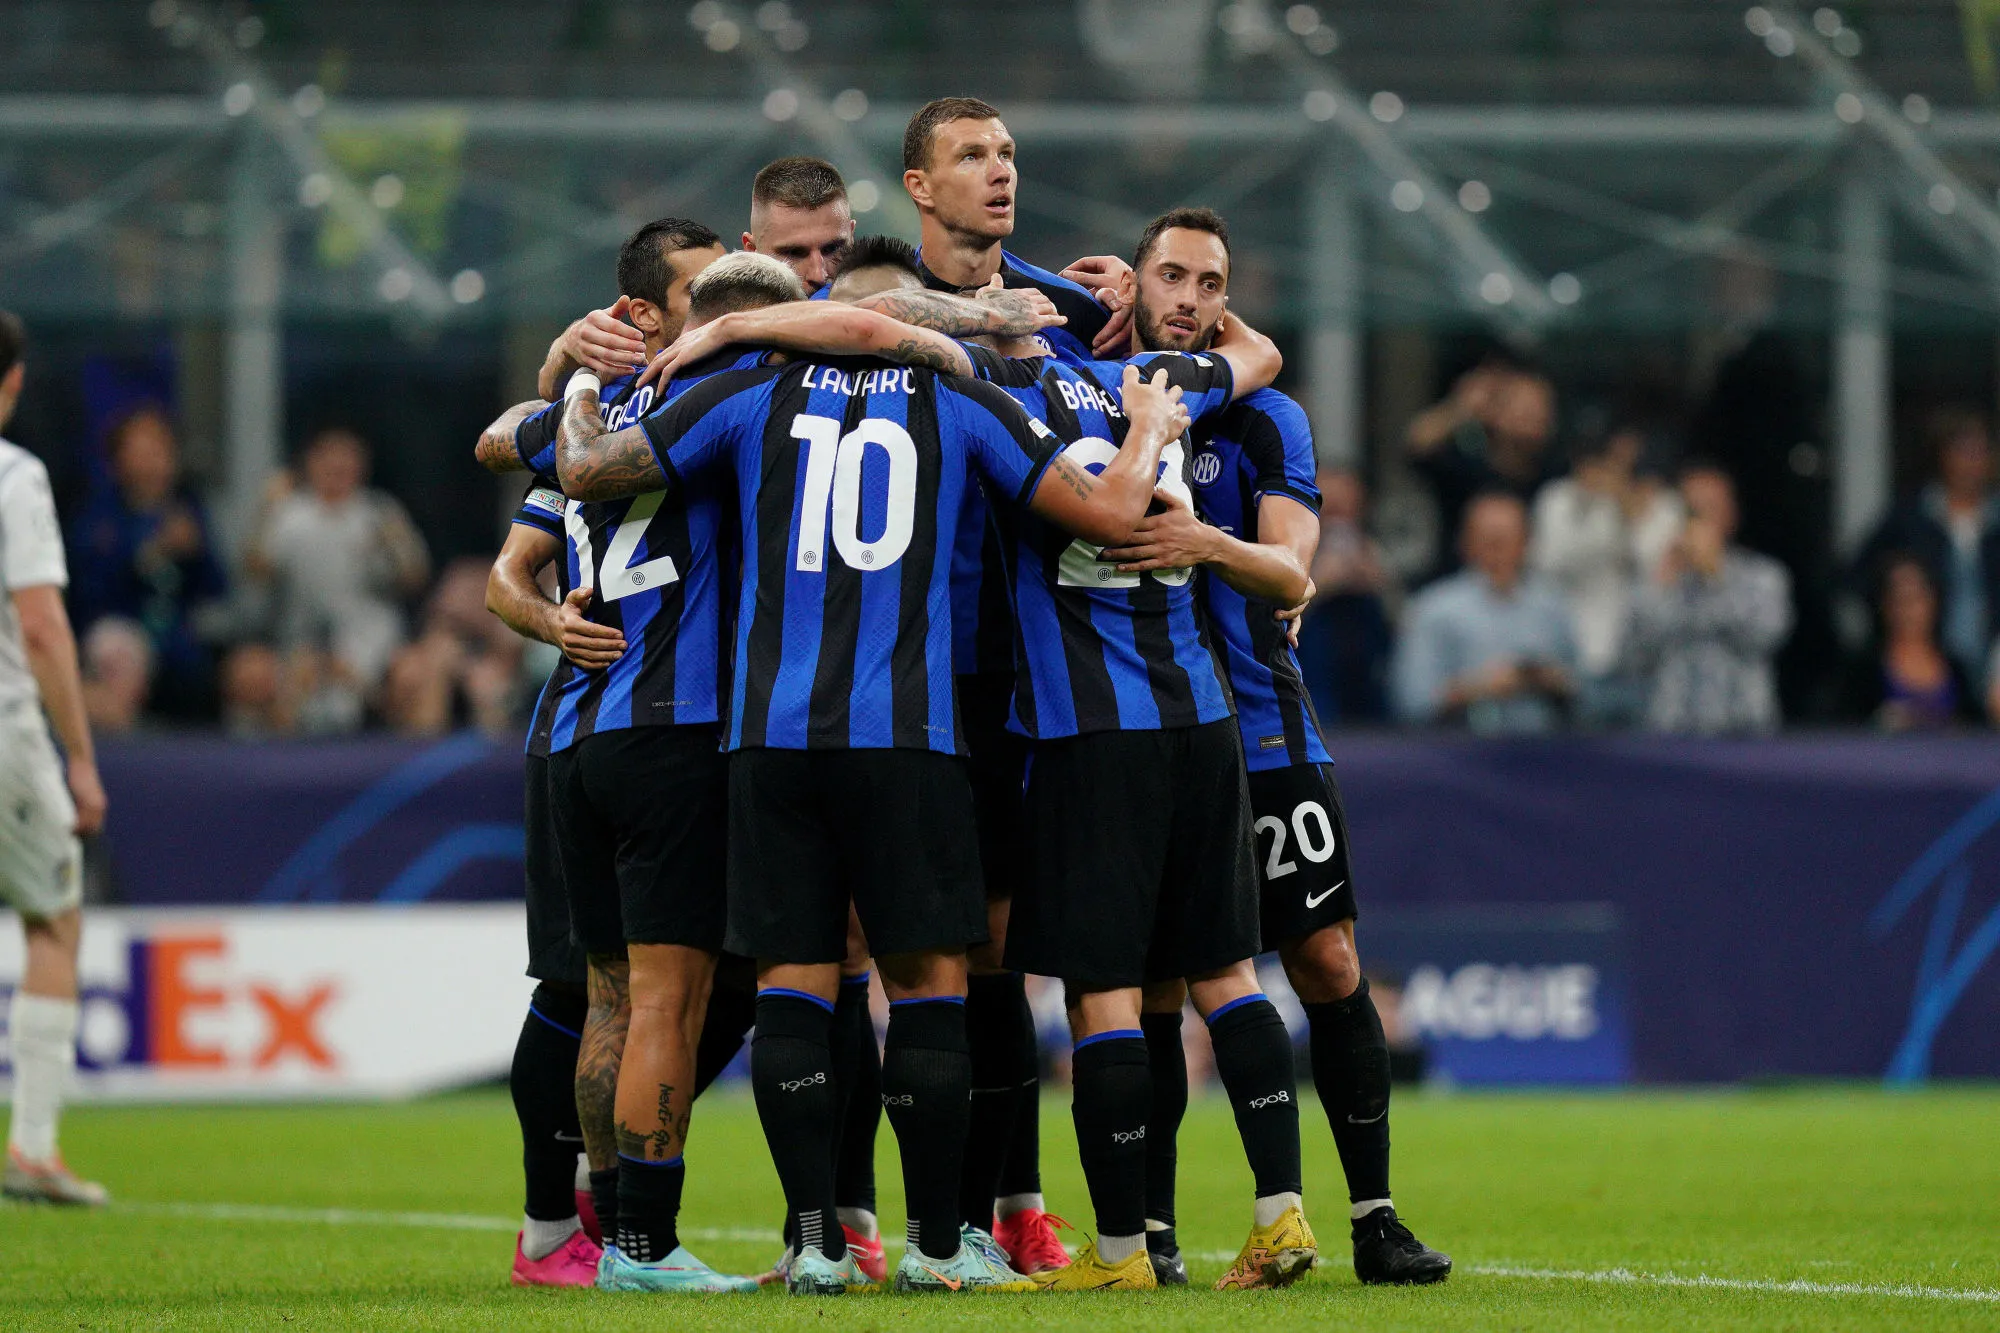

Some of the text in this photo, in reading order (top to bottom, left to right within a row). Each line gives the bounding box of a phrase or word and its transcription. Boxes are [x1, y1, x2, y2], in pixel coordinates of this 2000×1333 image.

[789, 413, 918, 572] 10
[1253, 801, 1335, 880] 20
[0, 935, 338, 1070] dEx
[1403, 964, 1598, 1041] AGUE
[778, 1072, 826, 1092] 1908
[880, 1093, 914, 1106] 908
[1249, 1090, 1290, 1109] 1908
[1111, 1125, 1146, 1144] 1908
